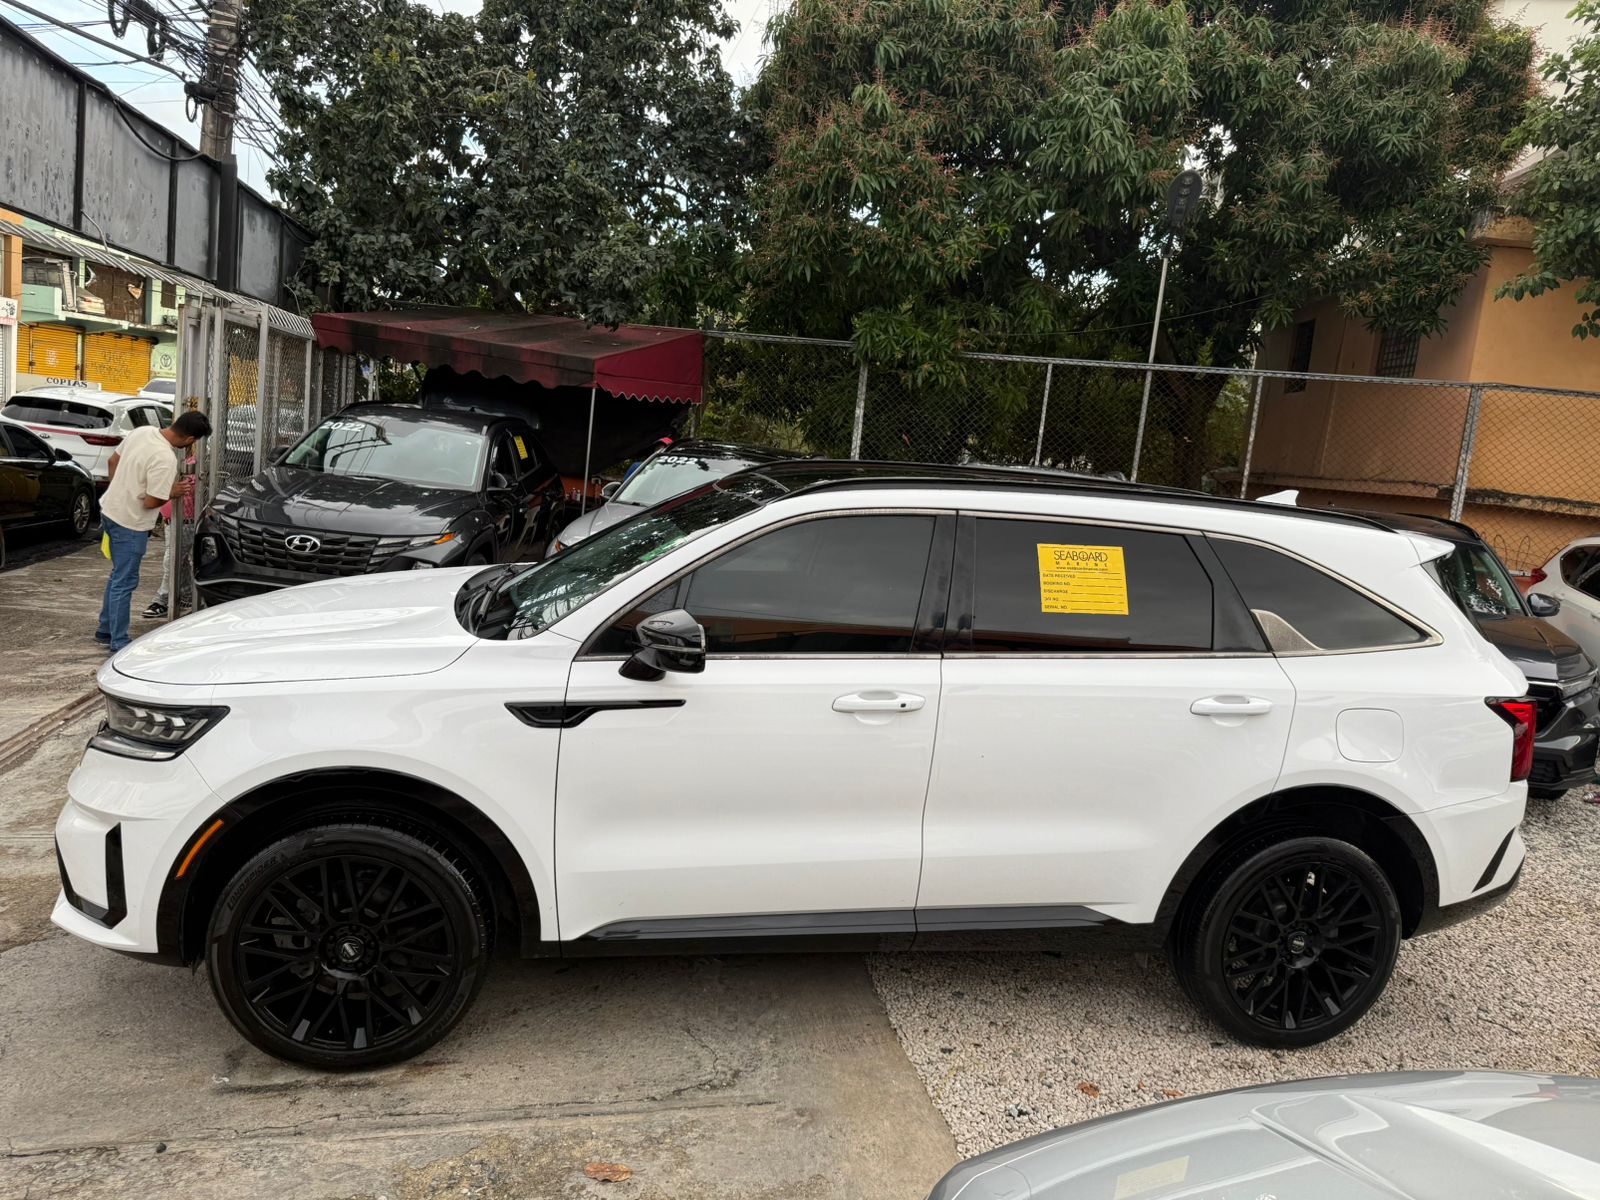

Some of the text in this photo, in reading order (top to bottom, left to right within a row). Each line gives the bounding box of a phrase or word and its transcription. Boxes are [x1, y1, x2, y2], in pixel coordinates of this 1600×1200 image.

[46, 377, 88, 388] COPIAS
[319, 420, 366, 432] 2022
[656, 455, 698, 464] 2022
[1053, 550, 1108, 562] SEABOARD
